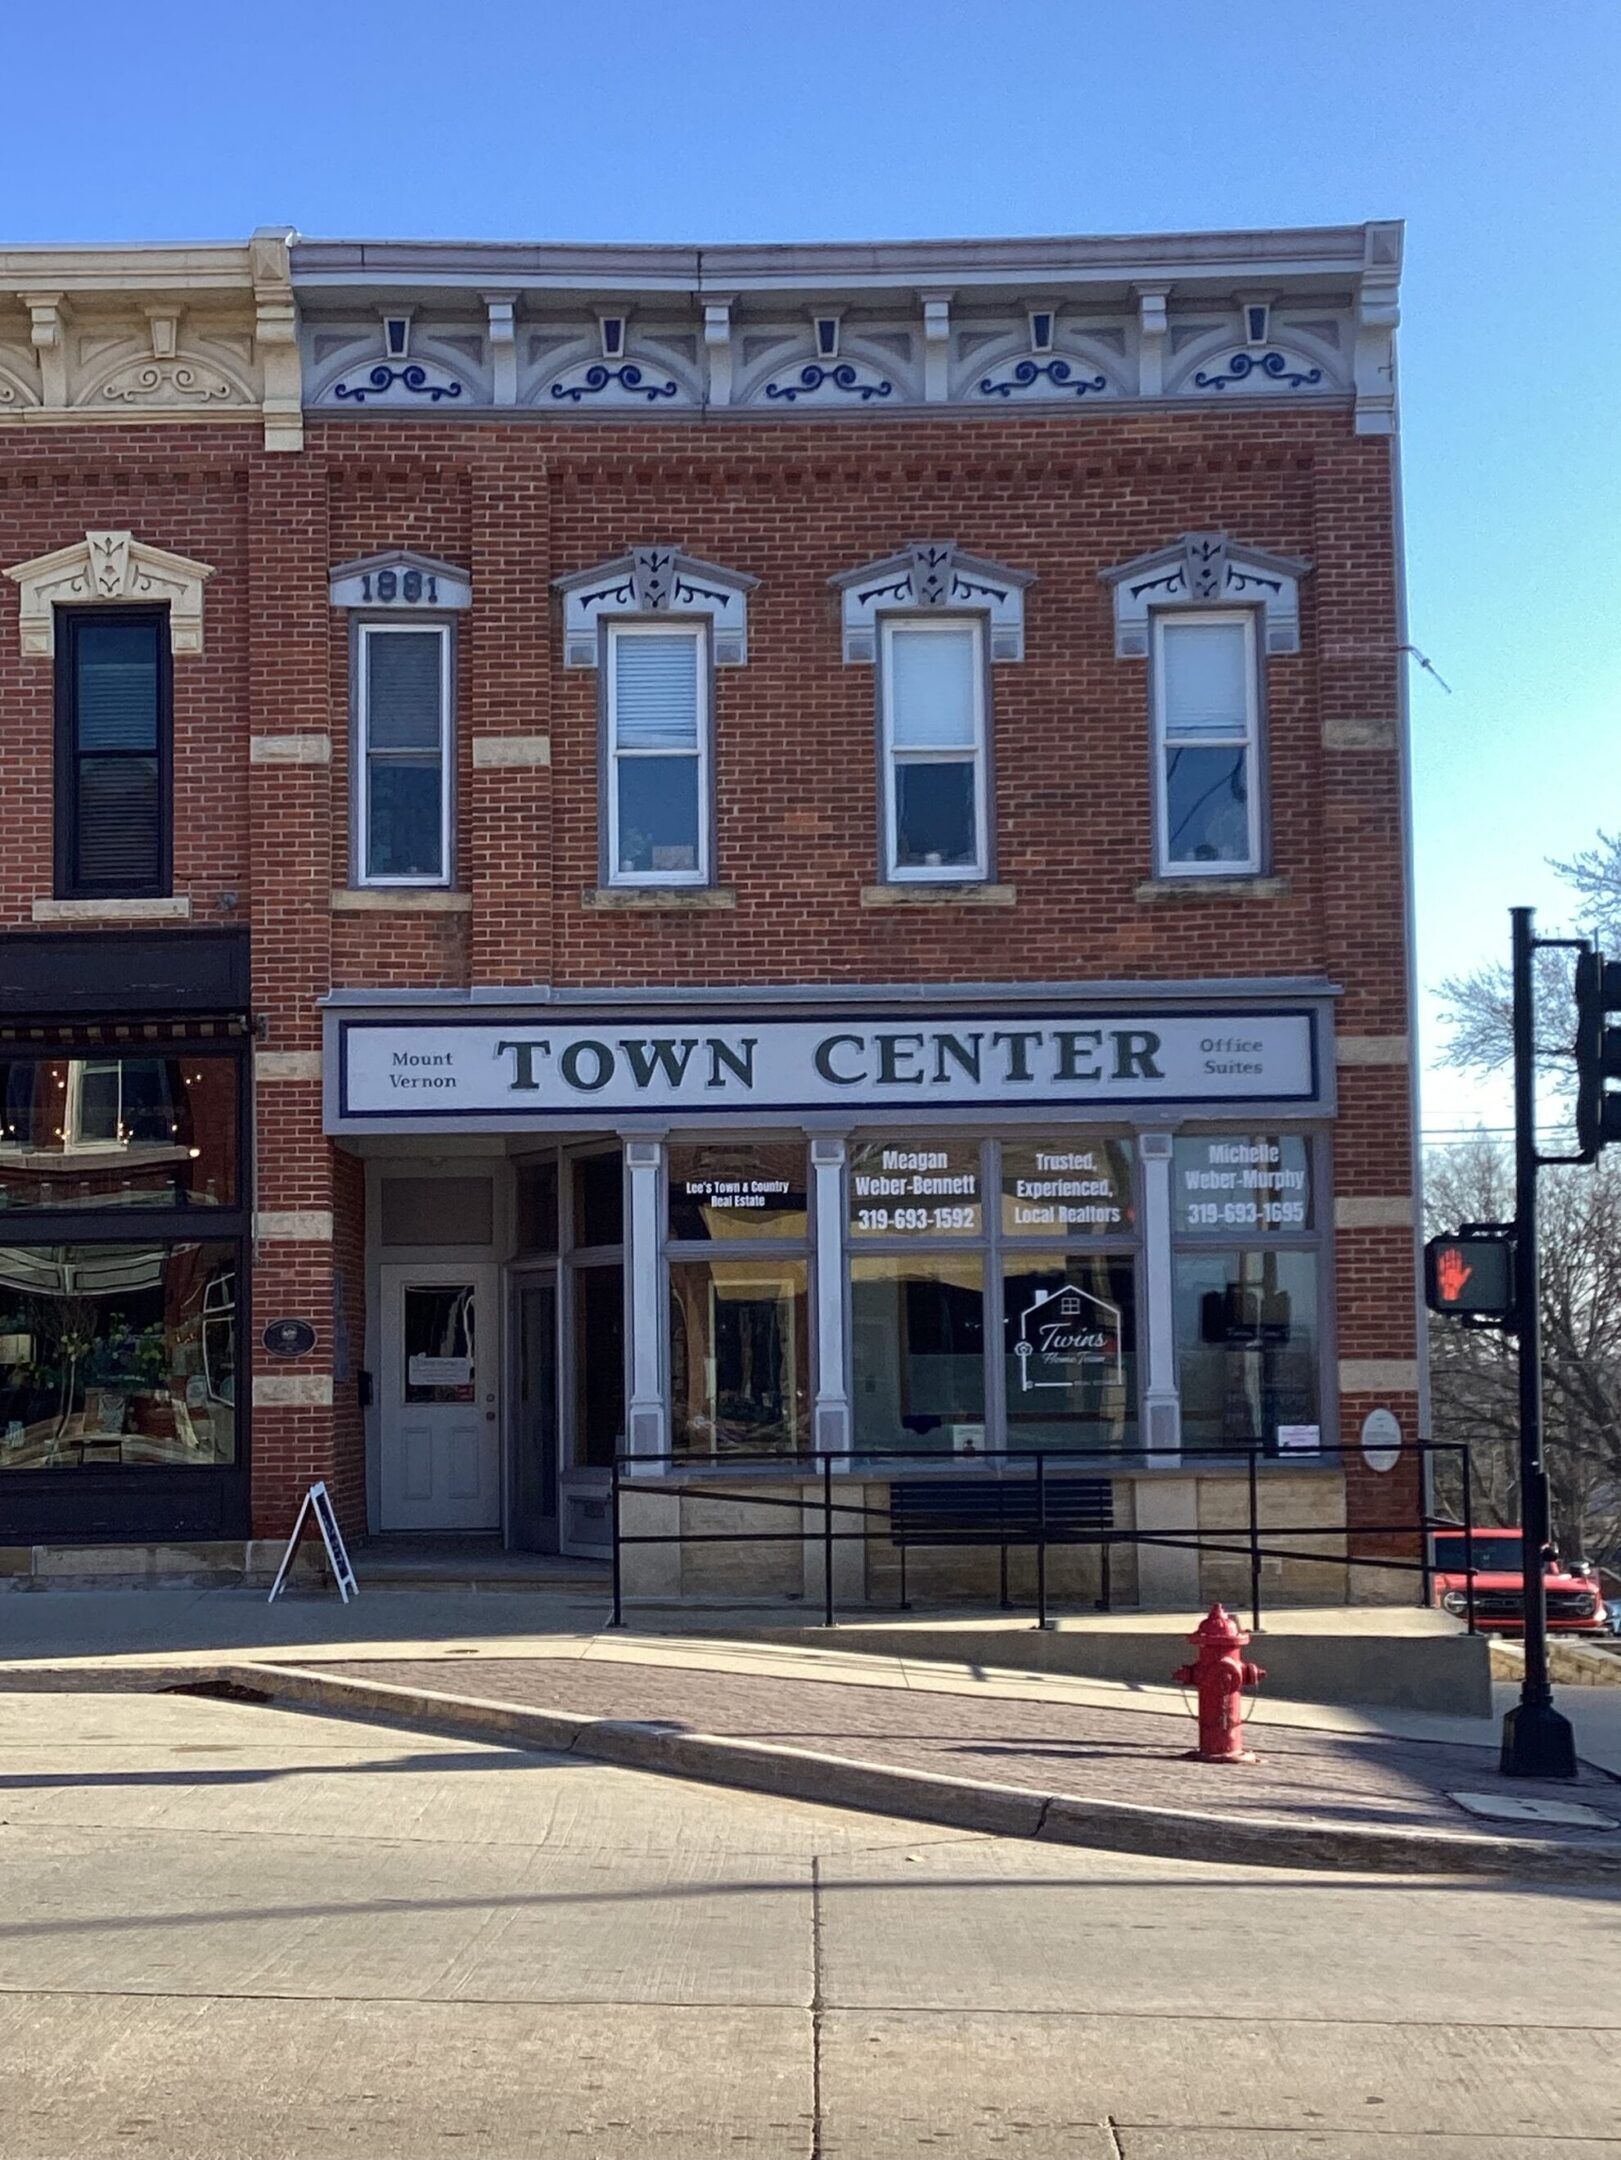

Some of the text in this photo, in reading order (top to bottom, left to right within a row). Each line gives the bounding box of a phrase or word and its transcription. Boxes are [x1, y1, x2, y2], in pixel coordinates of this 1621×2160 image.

[1200, 1037, 1264, 1054] Office
[391, 1051, 454, 1067] Mount
[496, 1029, 1166, 1091] TOWN CENTER
[1204, 1058, 1264, 1075] Suites
[389, 1073, 457, 1089] Vernon
[882, 1150, 948, 1171] Meagan
[1208, 1143, 1280, 1164] Michelle
[686, 1180, 790, 1194] Lee's Town & Country
[855, 1175, 976, 1196] Weber-Bennett
[1185, 1168, 1305, 1191] Weber-Murphy
[711, 1195, 766, 1207] Real Estate
[858, 1207, 975, 1230] 319-693-1592
[1015, 1205, 1121, 1224] Local Realtors
[1039, 1322, 1108, 1352] Twins
